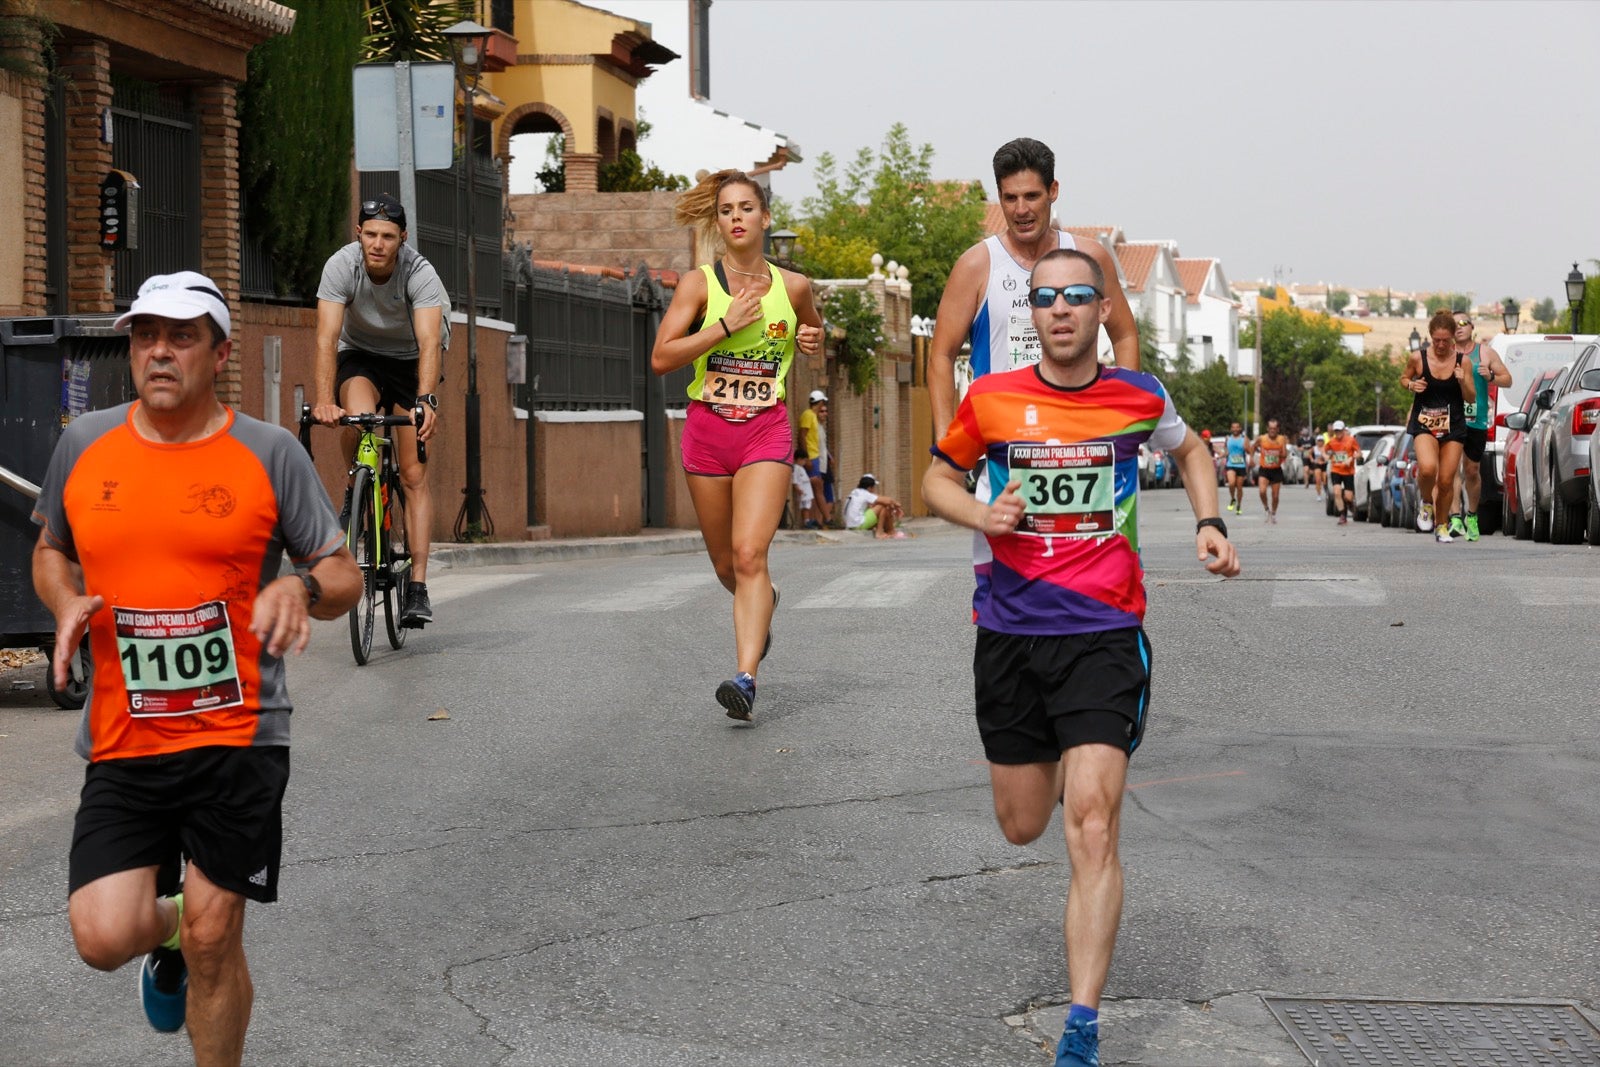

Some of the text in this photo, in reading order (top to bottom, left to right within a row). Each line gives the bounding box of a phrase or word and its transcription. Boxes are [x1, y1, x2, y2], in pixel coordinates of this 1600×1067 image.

[1012, 298, 1029, 308] MA
[1022, 352, 1042, 361] aec
[713, 377, 771, 402] 2169
[1422, 417, 1448, 428] 2247
[1014, 446, 1108, 459] XXXII GRAN PREMIO DE FONDO
[1028, 473, 1099, 506] 367
[117, 606, 218, 627] XXXII GRAN PREMIO DE FONDO
[121, 636, 229, 681] 1109
